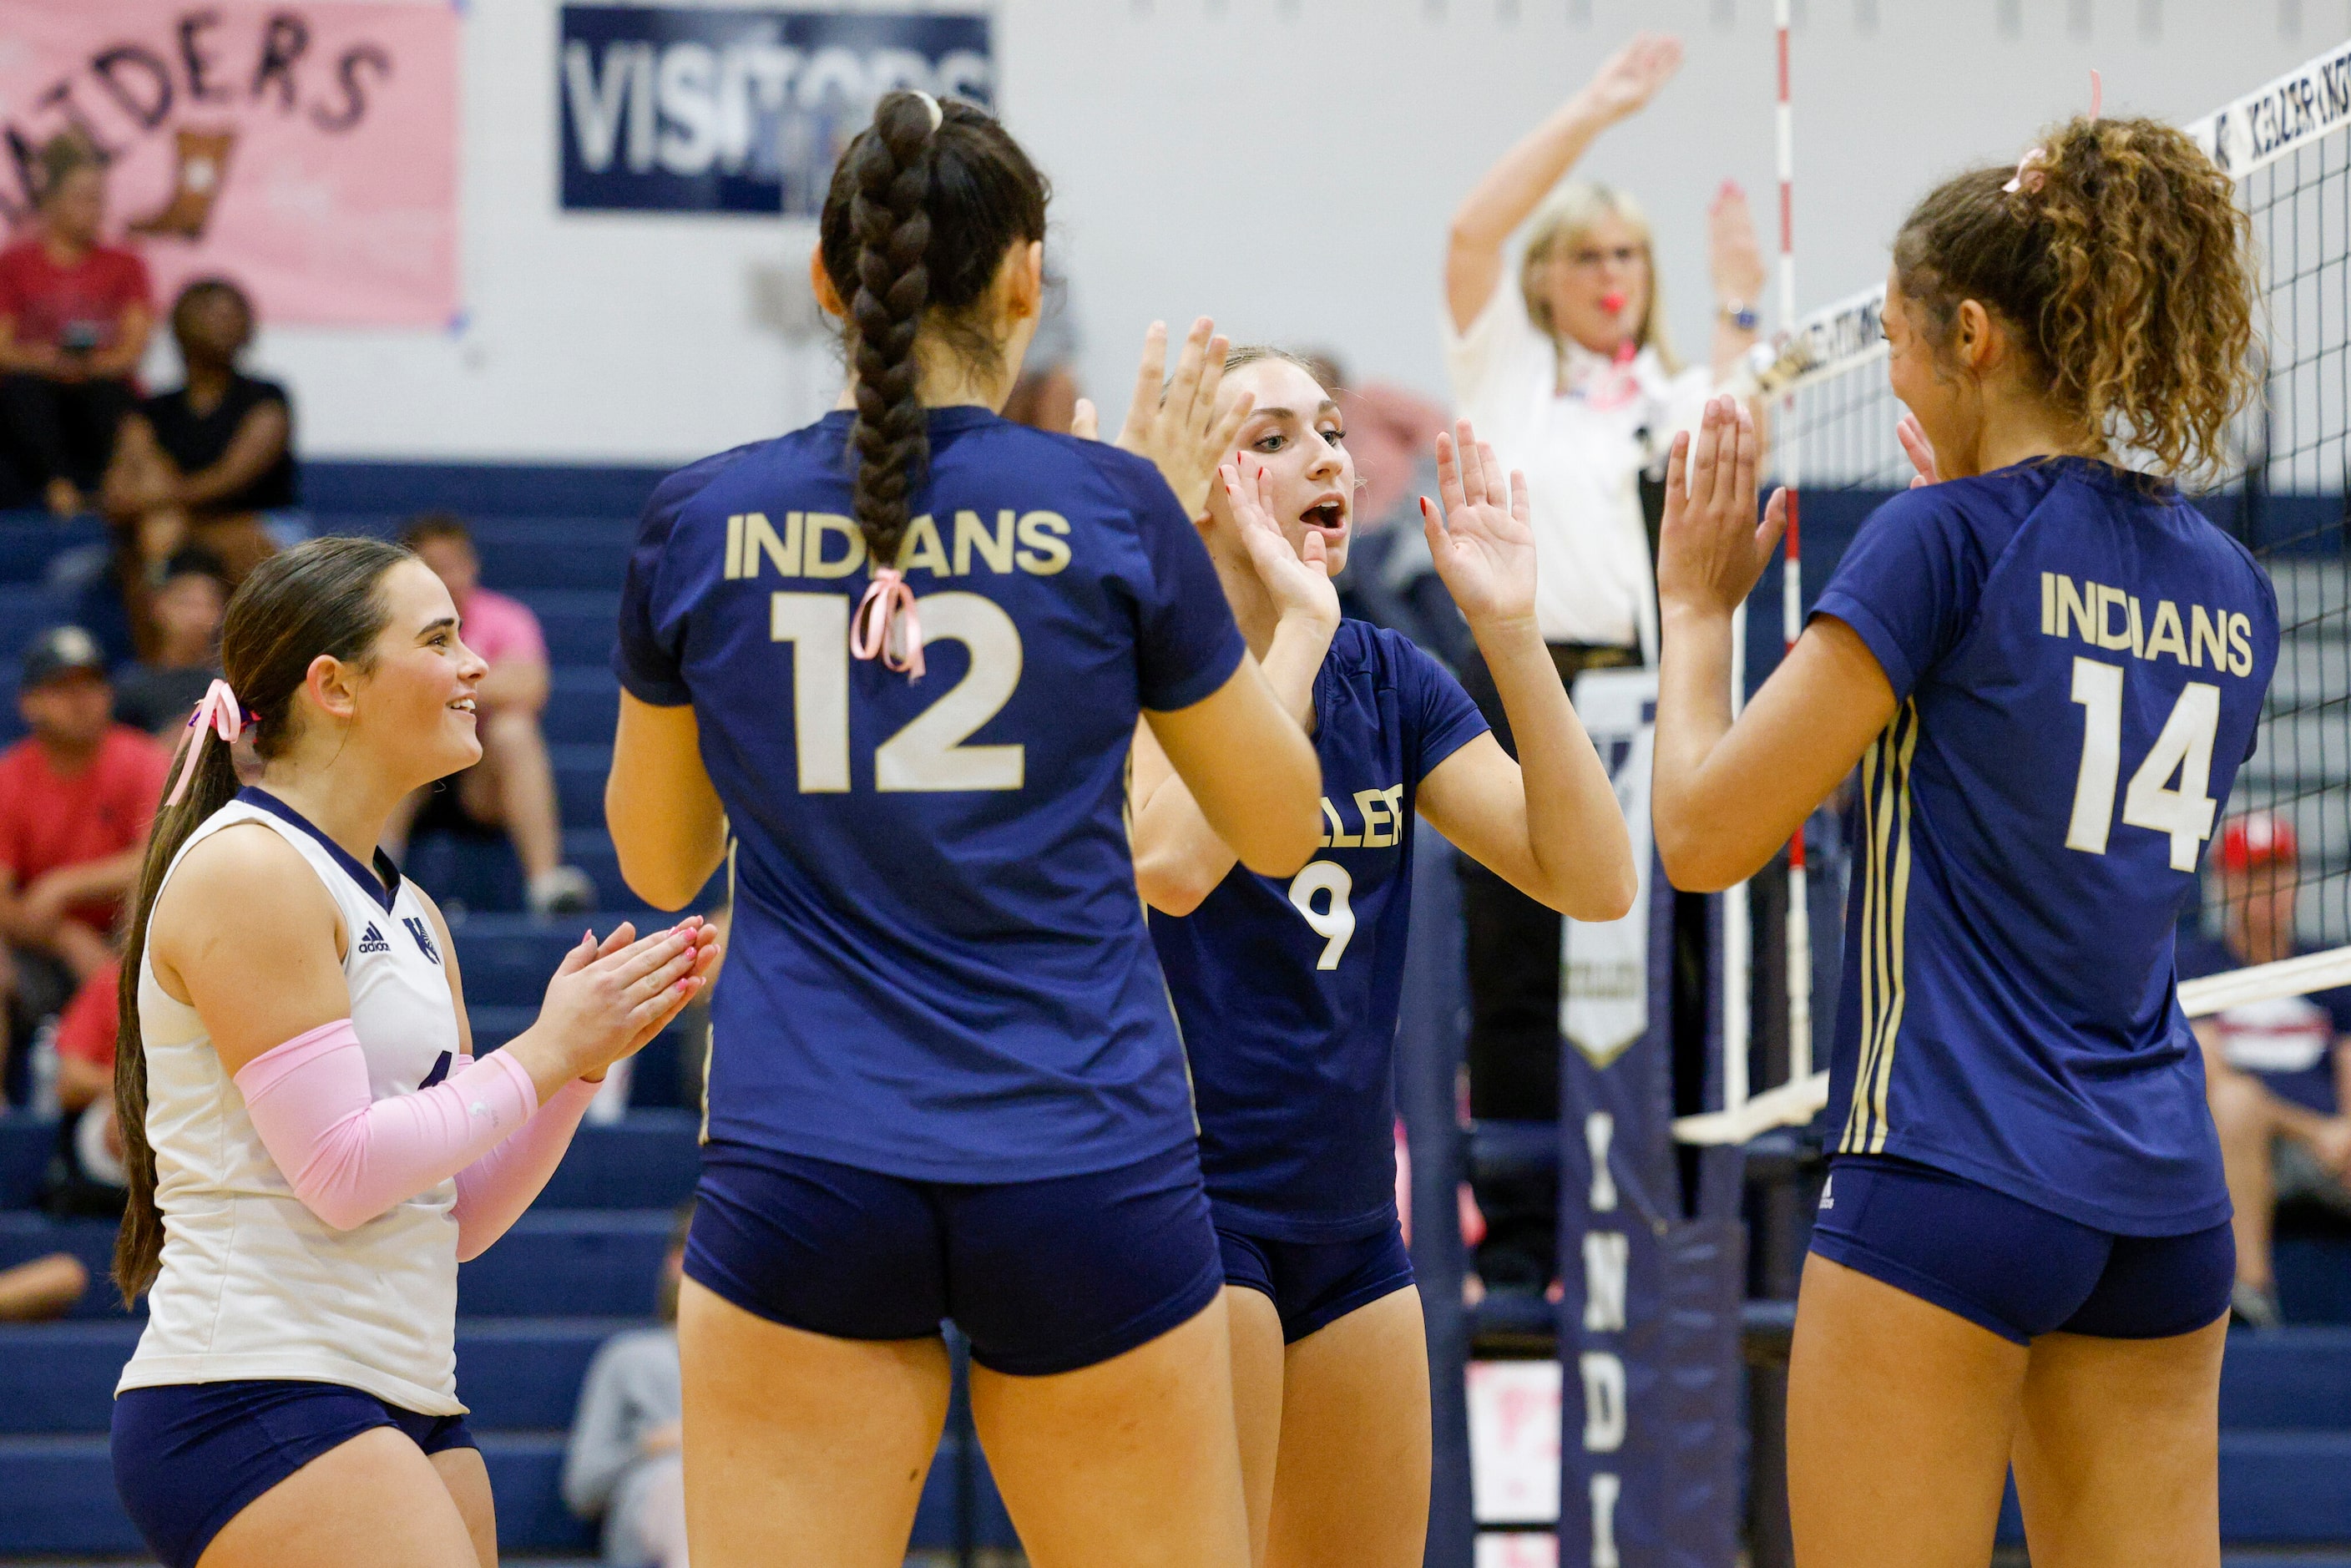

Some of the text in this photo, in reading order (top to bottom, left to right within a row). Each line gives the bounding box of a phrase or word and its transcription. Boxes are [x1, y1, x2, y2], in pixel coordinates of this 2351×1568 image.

[0, 7, 396, 225] AIDERS
[2318, 52, 2351, 124] IND
[724, 509, 1073, 580] INDANS
[2041, 571, 2253, 678] INDIANS
[770, 590, 1026, 794] 12
[1318, 782, 1403, 848] LER
[2064, 655, 2222, 873] 14
[1288, 859, 1356, 971] 9
